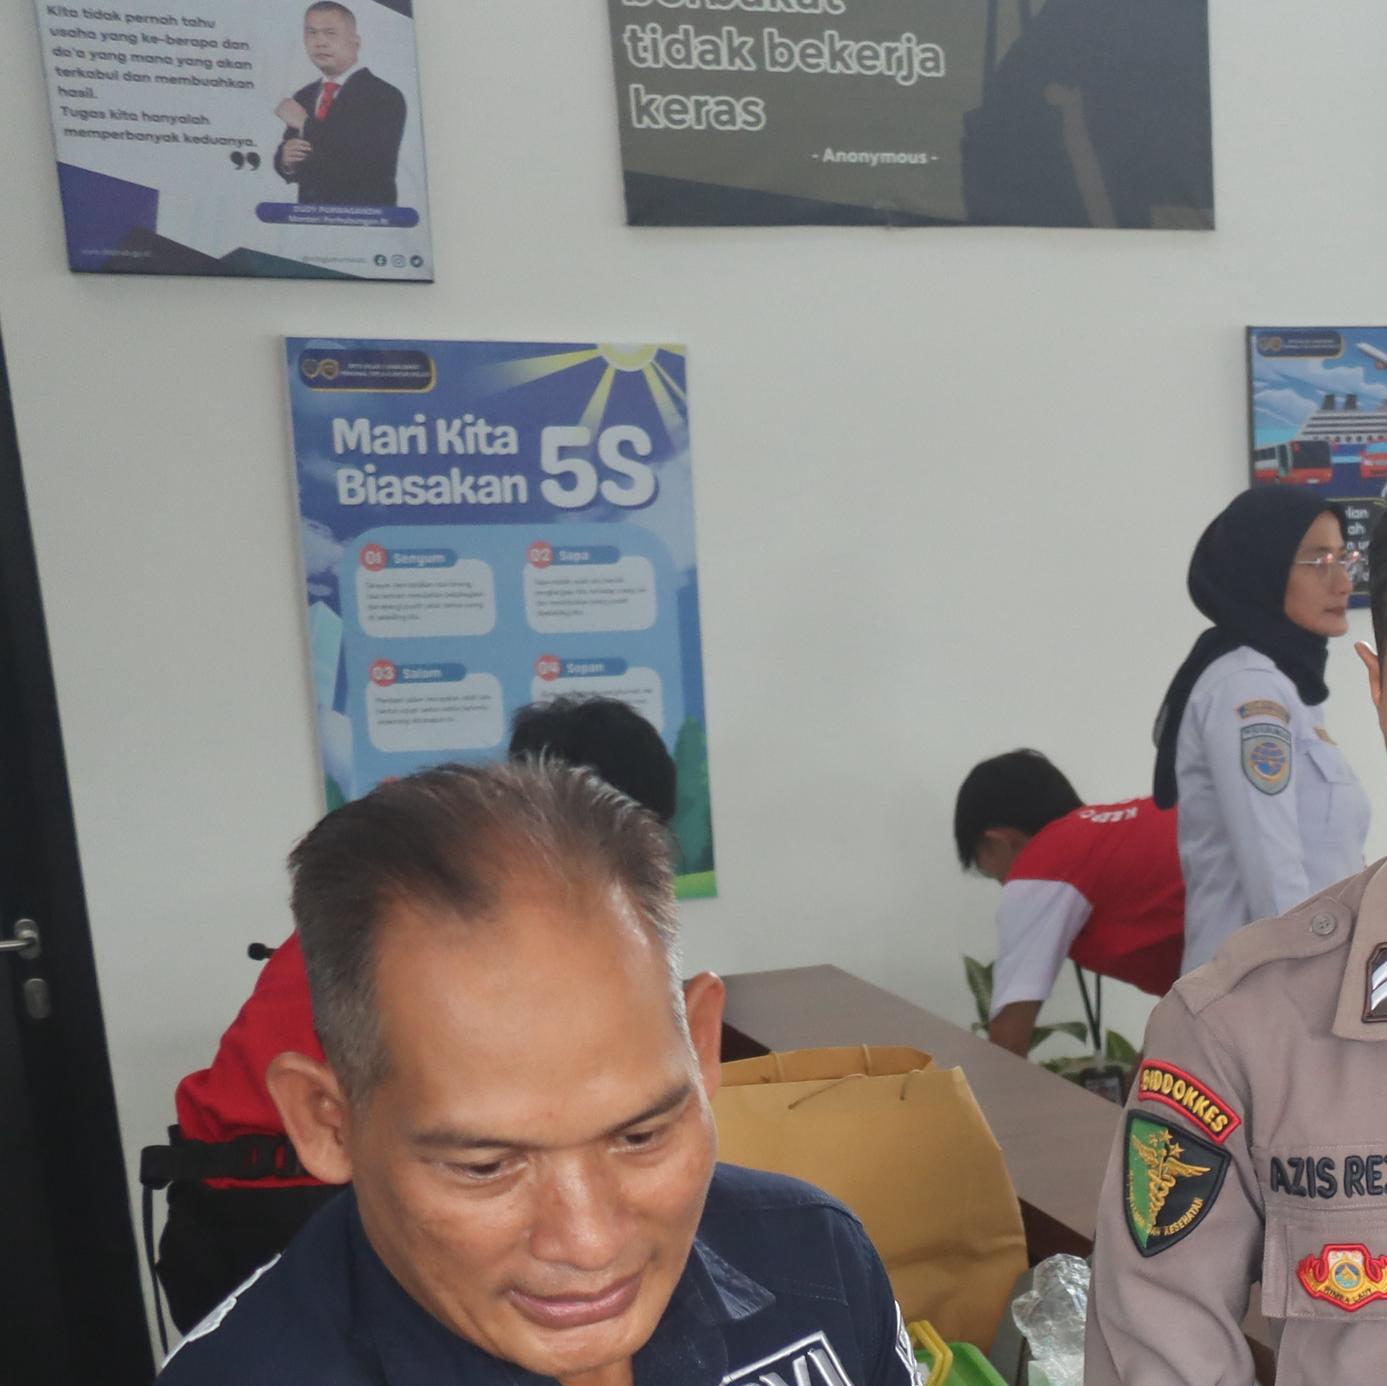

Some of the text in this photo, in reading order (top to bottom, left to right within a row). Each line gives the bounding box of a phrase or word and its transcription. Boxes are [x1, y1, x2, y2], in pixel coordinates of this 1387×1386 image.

[47, 5, 215, 29] Kita tidak pernah tahu
[49, 27, 249, 51] usaha yang ke-berapa dan
[90, 51, 127, 64] yang
[131, 54, 172, 65] mana
[176, 57, 213, 70] yang
[217, 57, 252, 70] akan
[624, 23, 945, 86] tidak bekerja
[55, 66, 254, 89] terkabul dan membuahkan
[57, 85, 98, 99] hasil.
[60, 106, 210, 125] Tugas kita hanyalah
[629, 83, 766, 131] keras
[64, 127, 258, 148] memperbanyak keduanya.
[822, 148, 927, 166] Anonymous
[331, 413, 519, 456] Mari Kita
[540, 423, 660, 510] 5S
[336, 464, 529, 506] Biasakan
[1270, 1155, 1338, 1199] AZIS
